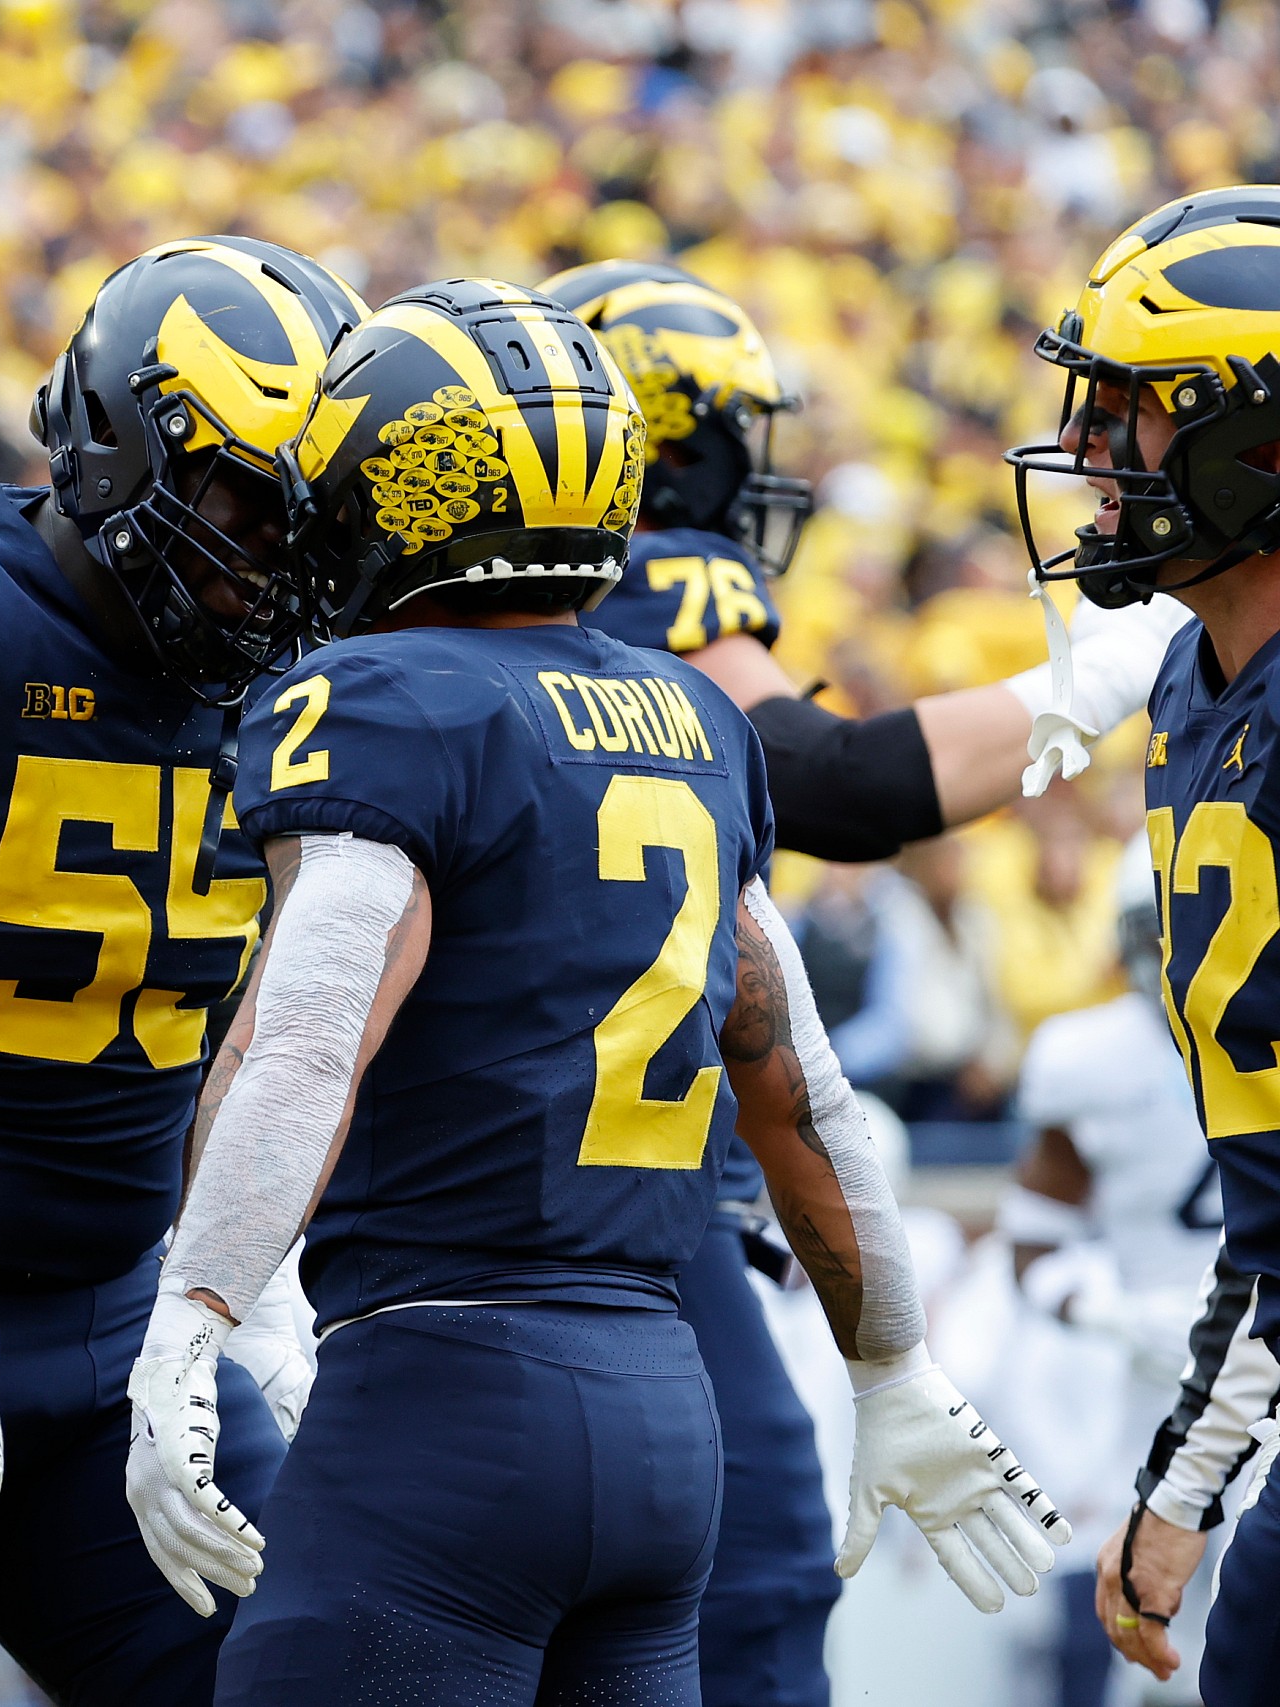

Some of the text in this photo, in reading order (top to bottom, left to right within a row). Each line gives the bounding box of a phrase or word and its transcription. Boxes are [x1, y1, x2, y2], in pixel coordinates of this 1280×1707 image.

[406, 499, 434, 512] TED
[491, 487, 508, 513] 2
[646, 556, 768, 653] 76
[269, 674, 332, 792] 2
[537, 670, 714, 763] CORUM
[577, 774, 723, 1171] 2
